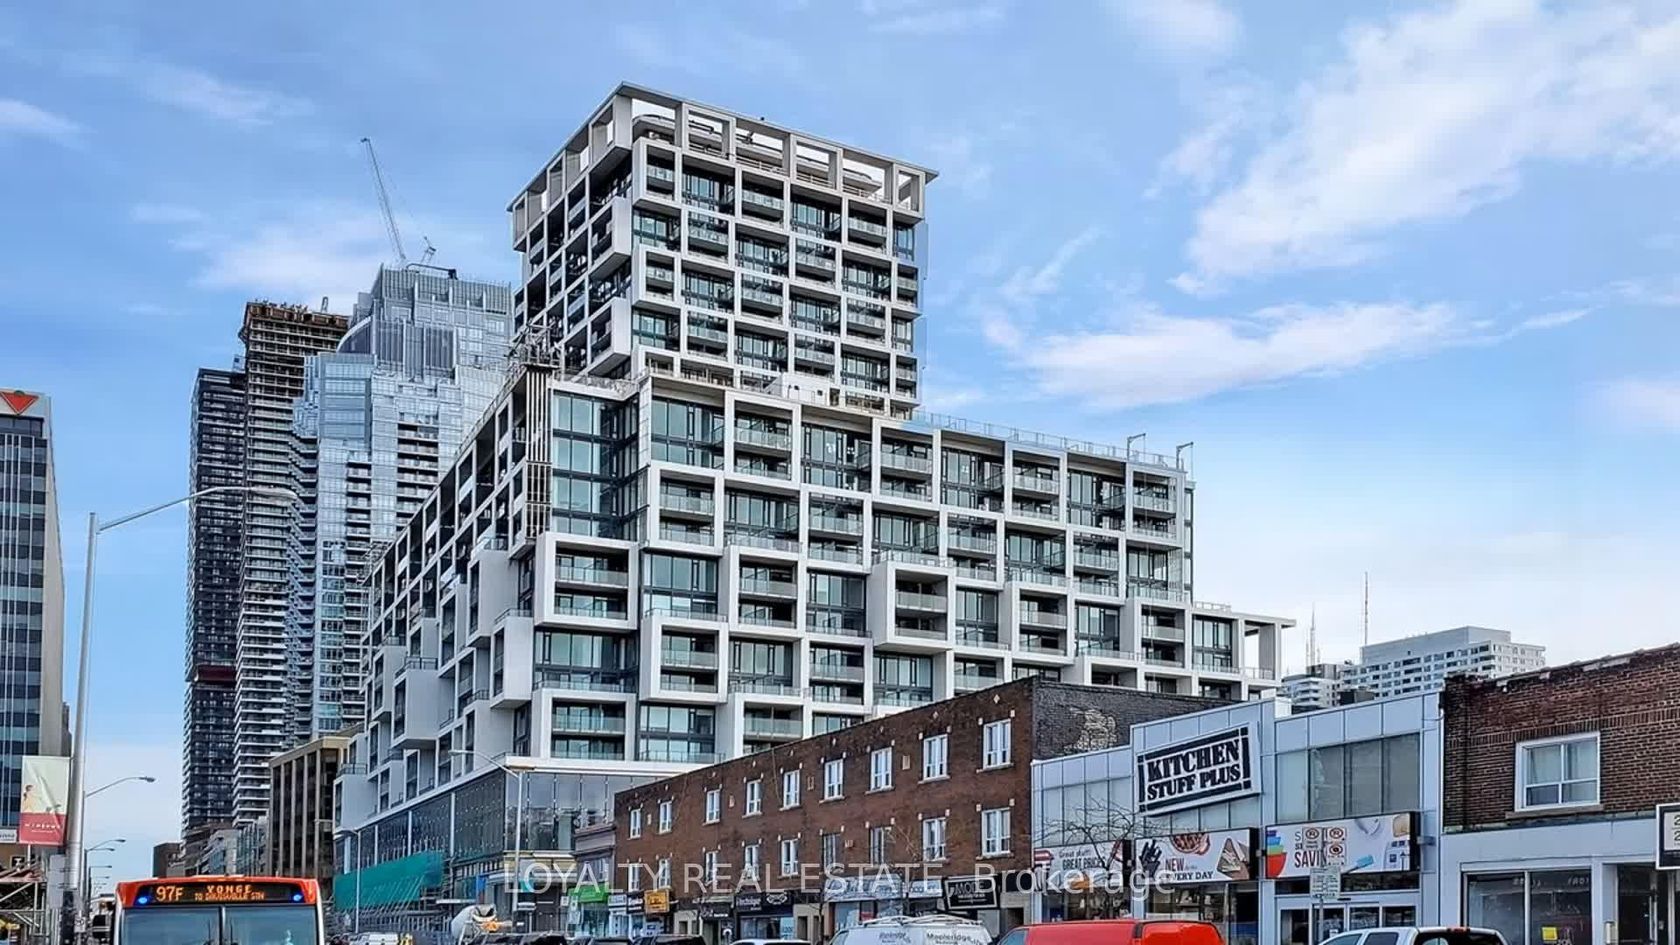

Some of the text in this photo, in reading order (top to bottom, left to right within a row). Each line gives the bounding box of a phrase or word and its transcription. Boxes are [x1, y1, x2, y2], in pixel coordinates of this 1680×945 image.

[1147, 739, 1240, 782] KITCHEN
[1147, 763, 1241, 800] STUFF PLUS
[1165, 857, 1185, 871] NEW
[1195, 871, 1214, 880] DAY
[156, 884, 252, 902] 97F YONGE
